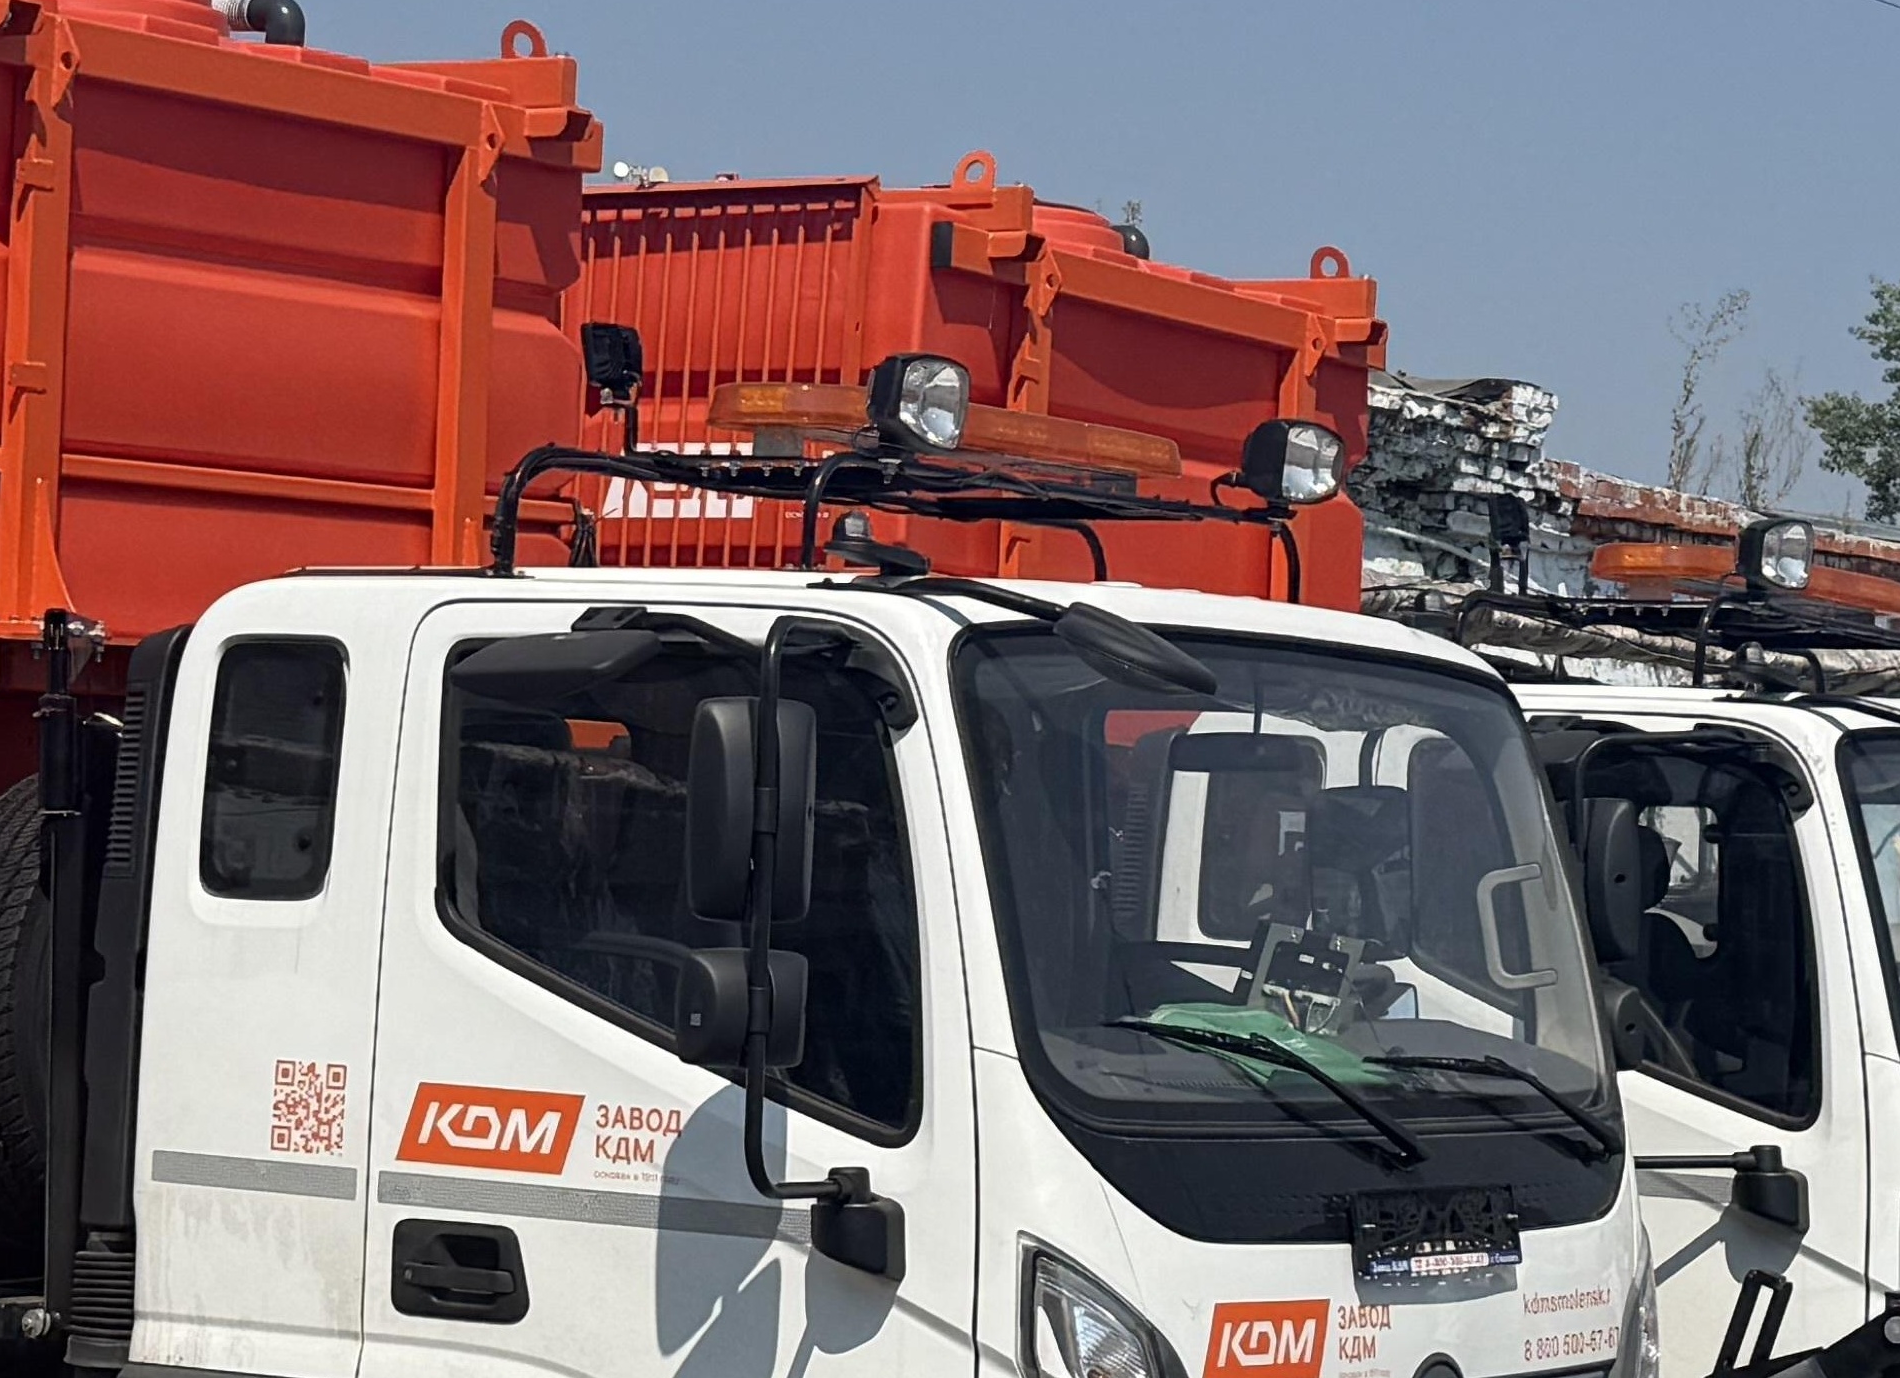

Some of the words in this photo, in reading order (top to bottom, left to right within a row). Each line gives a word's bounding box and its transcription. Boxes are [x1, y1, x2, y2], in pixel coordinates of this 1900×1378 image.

[417, 1101, 562, 1155] KDM
[595, 1104, 684, 1138] ЗАВОД
[594, 1135, 656, 1165] КДМ
[1337, 1305, 1392, 1332] ЗАВОД
[1217, 1318, 1317, 1368] KDM
[1338, 1336, 1378, 1363] КДМ
